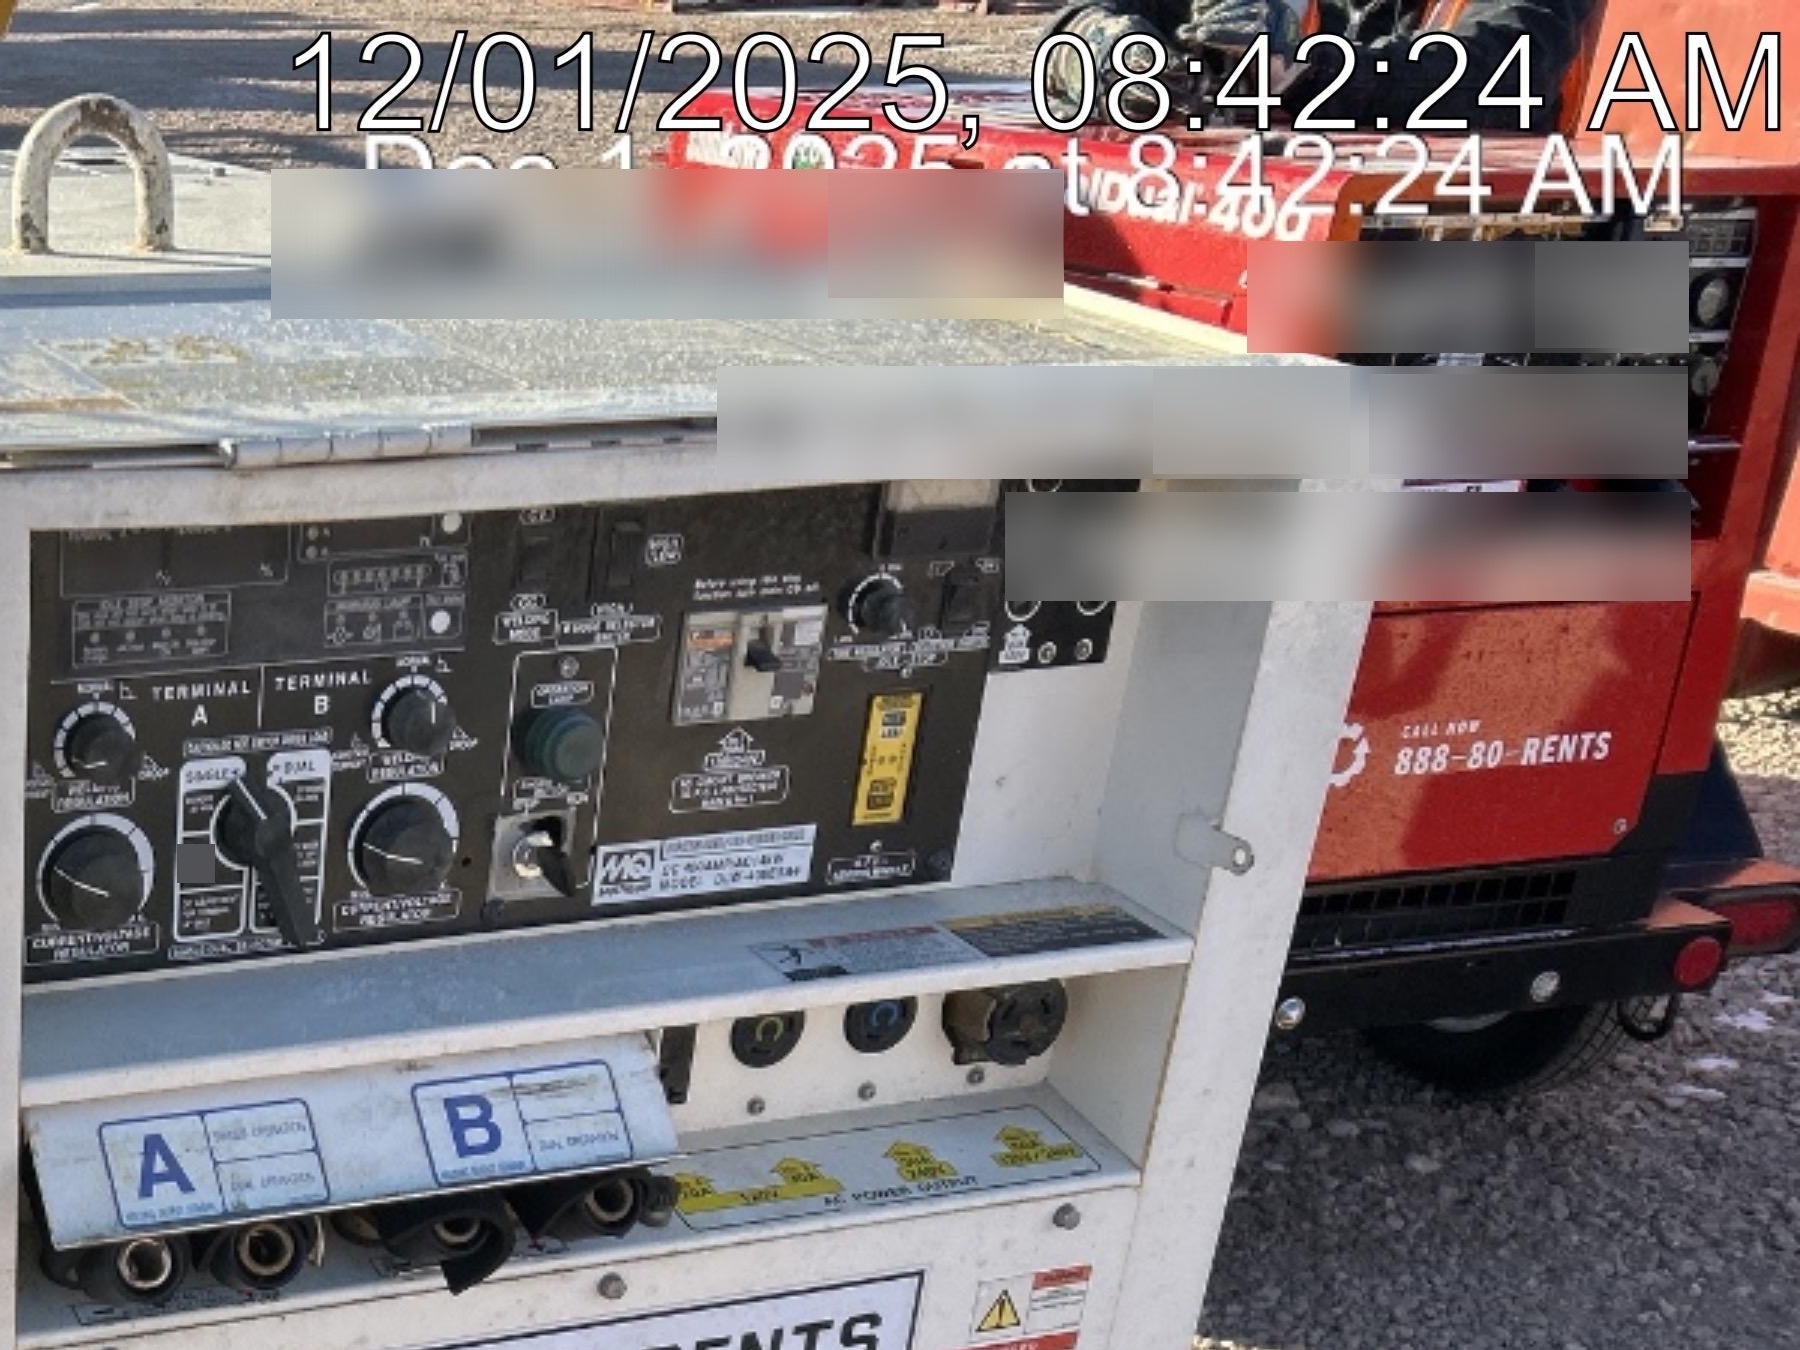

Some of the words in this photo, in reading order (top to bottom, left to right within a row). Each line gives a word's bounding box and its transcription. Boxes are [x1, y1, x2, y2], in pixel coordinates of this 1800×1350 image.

[153, 680, 251, 700] TERMINAL
[275, 670, 372, 692] TERMINAL
[314, 695, 331, 715] B
[191, 705, 208, 727] A
[1401, 721, 1439, 739] CALL
[1446, 719, 1481, 736] NOW
[1394, 731, 1612, 775] 888-80-RENTS
[283, 760, 316, 775] DUAL
[443, 1095, 501, 1158] B
[138, 1133, 195, 1198] A
[852, 1185, 912, 1201] POWER
